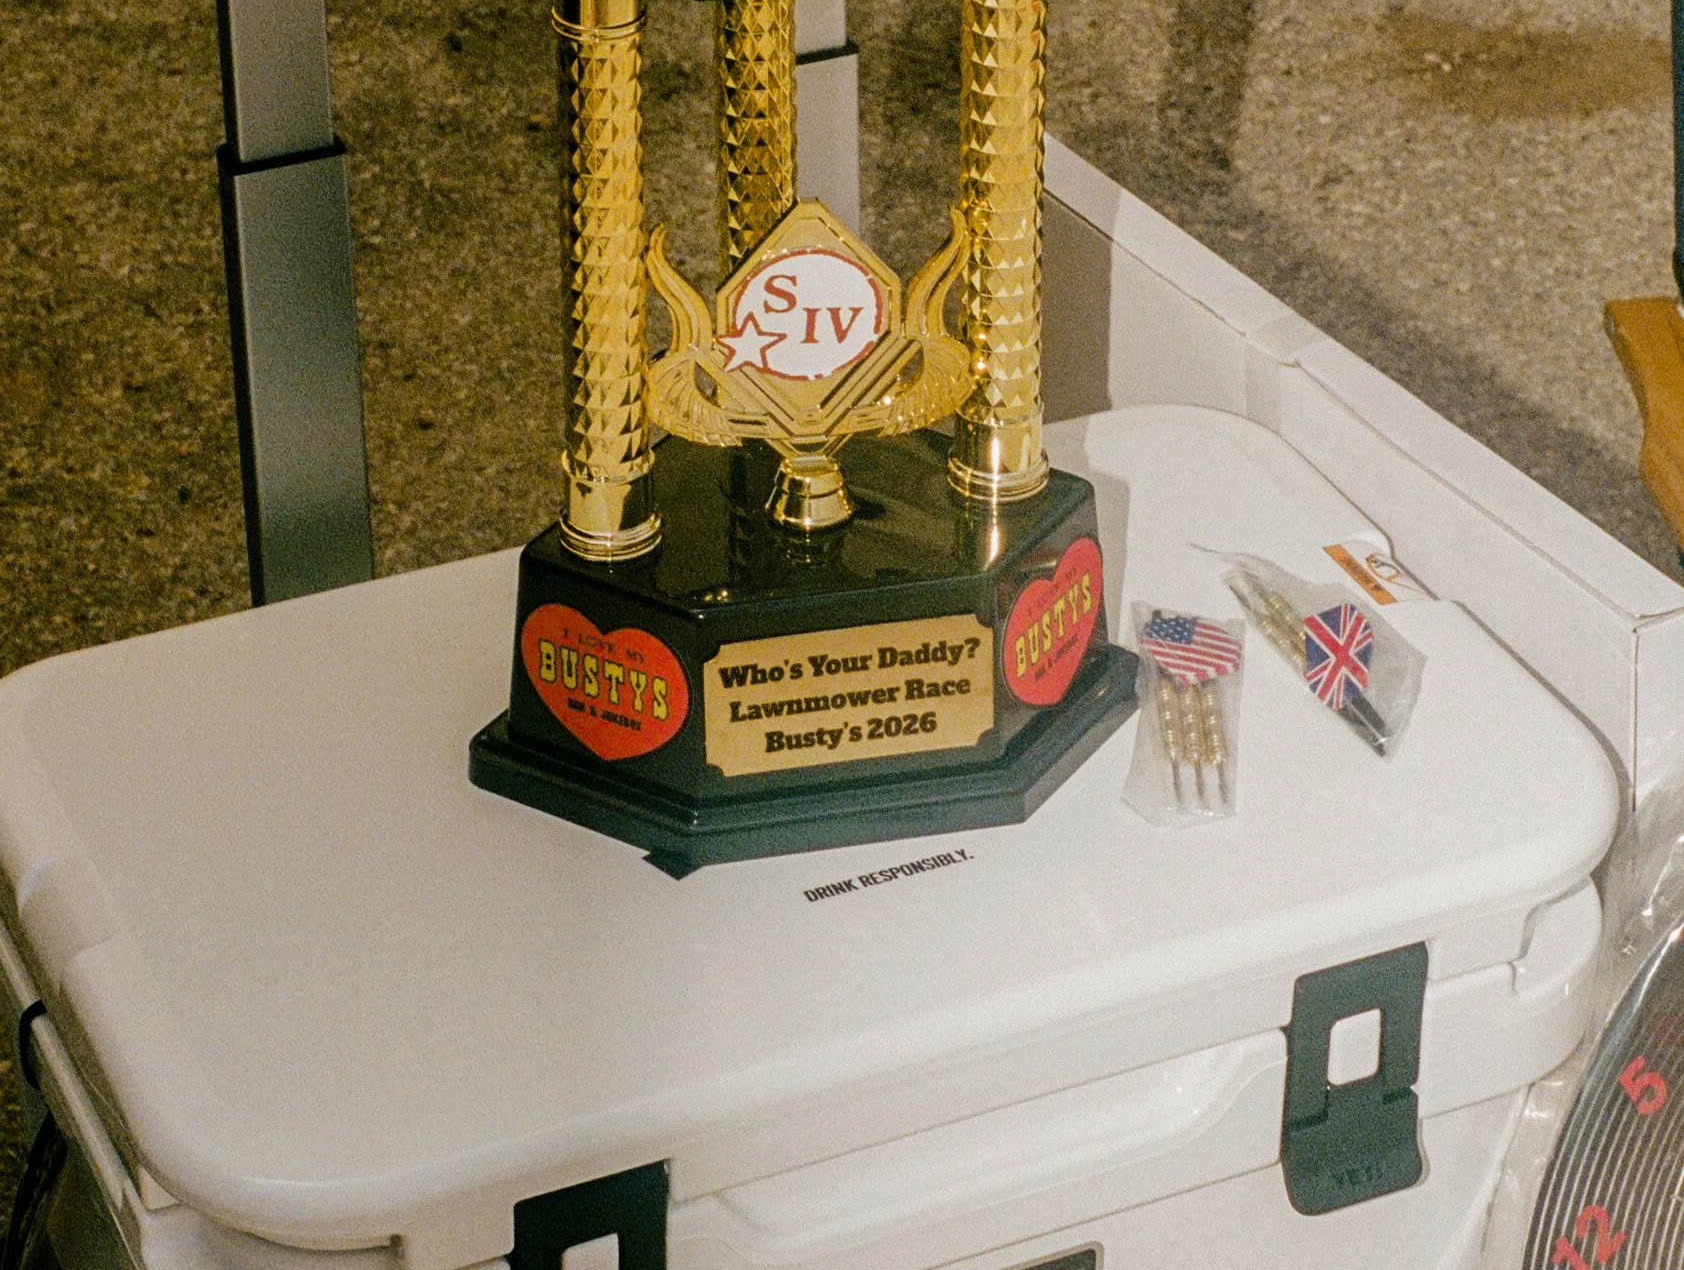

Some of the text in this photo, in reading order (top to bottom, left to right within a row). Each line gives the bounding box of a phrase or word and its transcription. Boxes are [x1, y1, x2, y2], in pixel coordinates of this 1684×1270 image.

[1015, 569, 1092, 678] BUSTYS
[538, 638, 669, 722] BUSTYS
[718, 637, 981, 689] Who's Your Daddy?
[729, 678, 972, 723] Lawnmower Race
[765, 711, 937, 753] Busty's 2026
[803, 848, 975, 902] DRINK RESPONSIBLY.
[1616, 1055, 1668, 1115] 5
